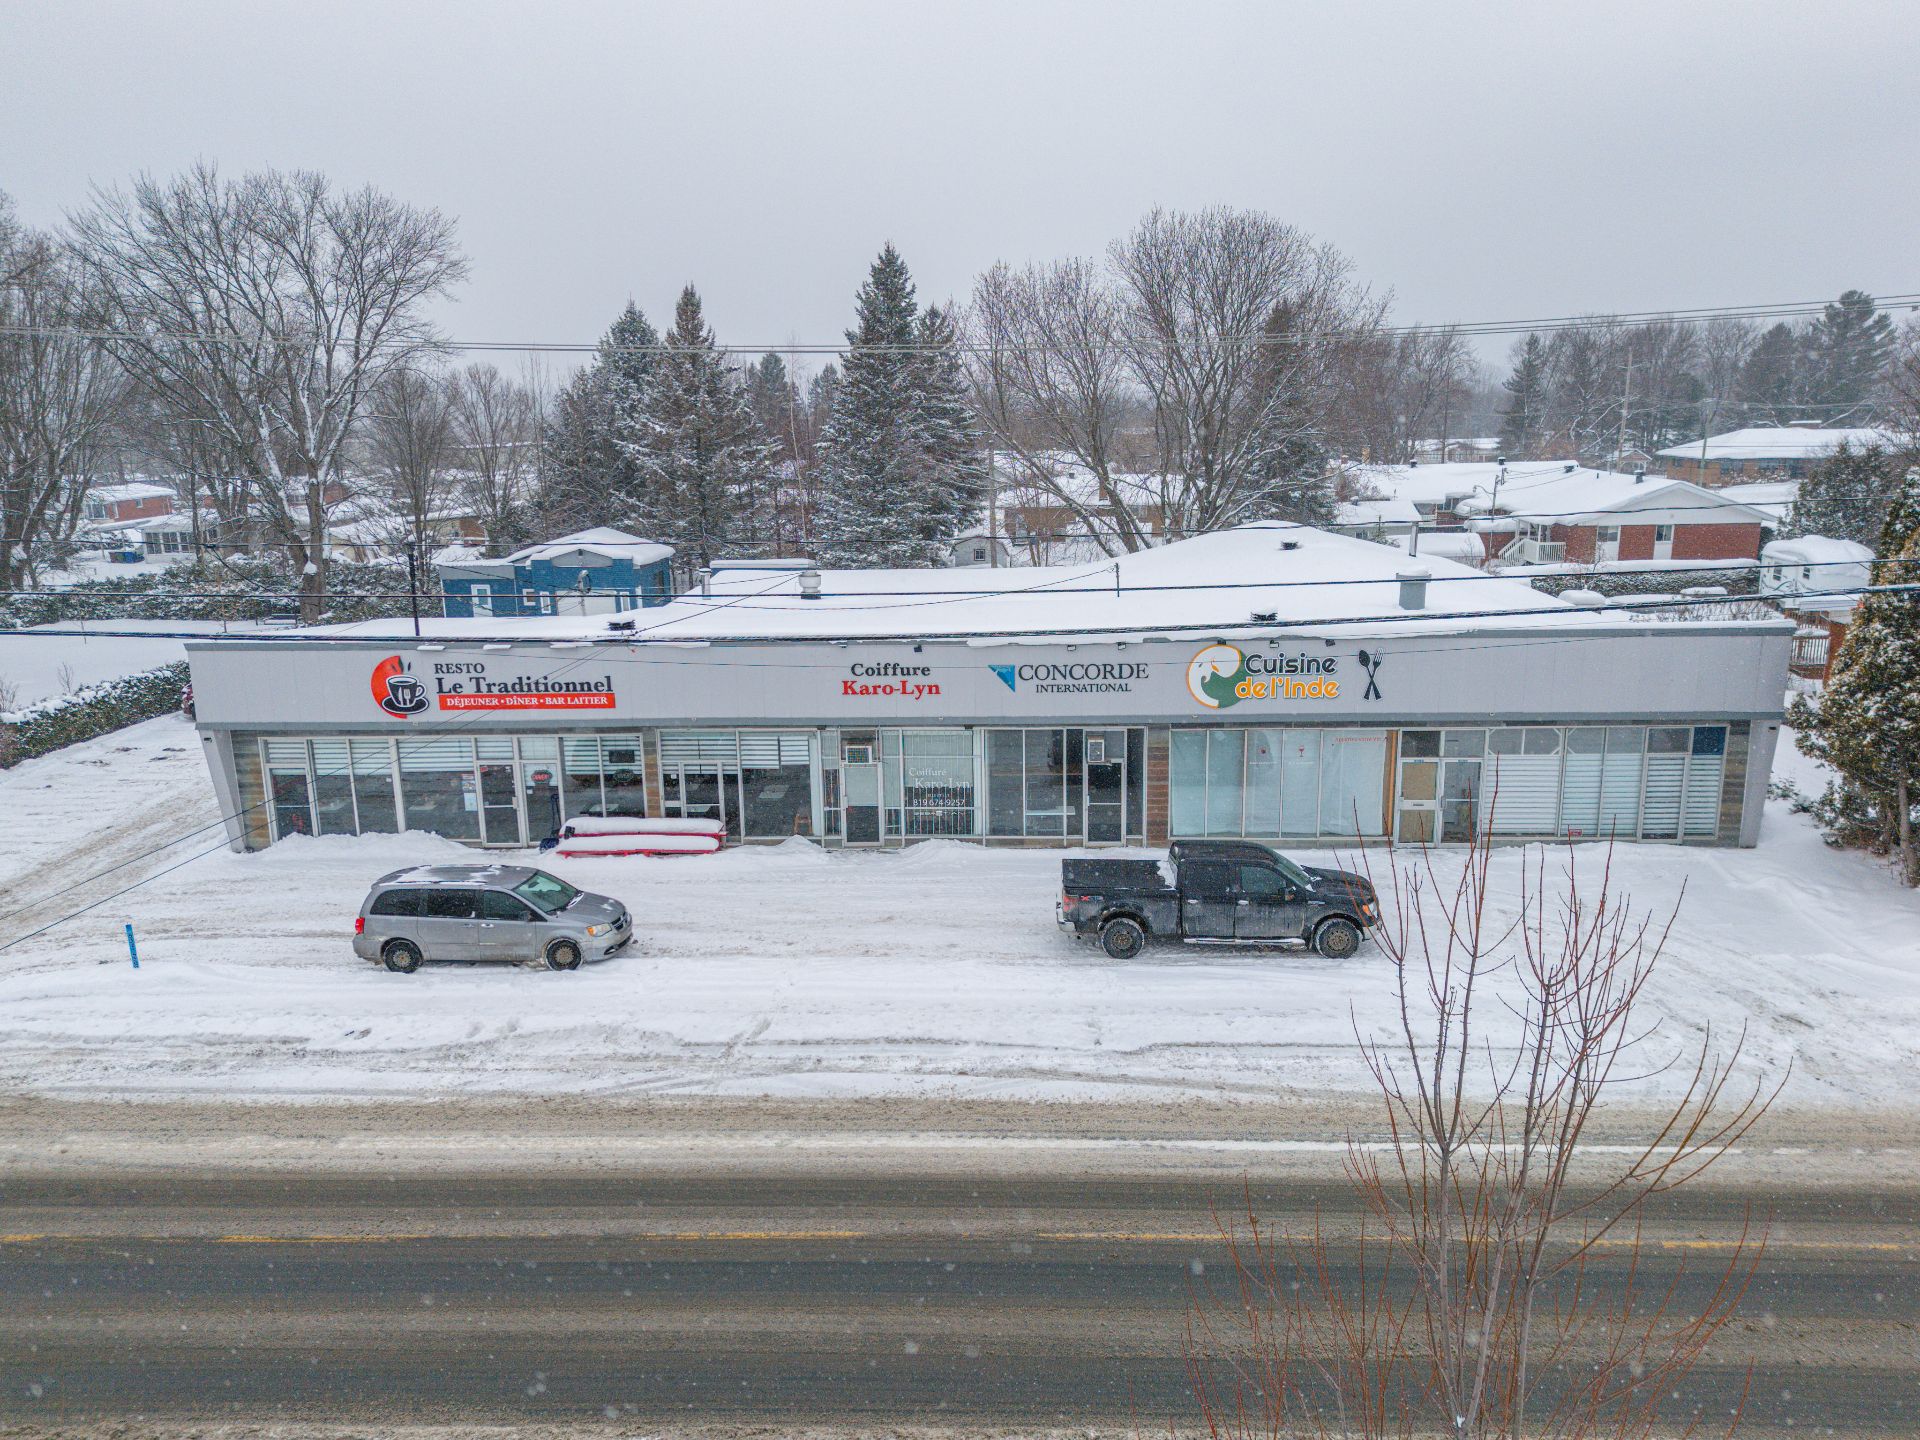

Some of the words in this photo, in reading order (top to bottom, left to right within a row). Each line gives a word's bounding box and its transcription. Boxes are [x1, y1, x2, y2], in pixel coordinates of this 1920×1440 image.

[434, 663, 485, 674] RESTO
[851, 663, 931, 676] Coiffure
[1245, 652, 1337, 674] Cuisine
[1018, 663, 1149, 681] CONCORDE
[437, 677, 463, 694] Le
[469, 675, 614, 694] Traditionnel
[842, 680, 942, 700] Karo-Lyn
[1036, 683, 1132, 693] INTERNATIONAL
[1235, 677, 1267, 698] de
[1270, 676, 1340, 698] l'Inde
[447, 696, 499, 707] DÉJEUNER
[506, 695, 539, 705] DÎNER
[545, 697, 565, 705] BAR
[567, 696, 608, 705] LAITIER
[909, 767, 947, 776] Coiffure
